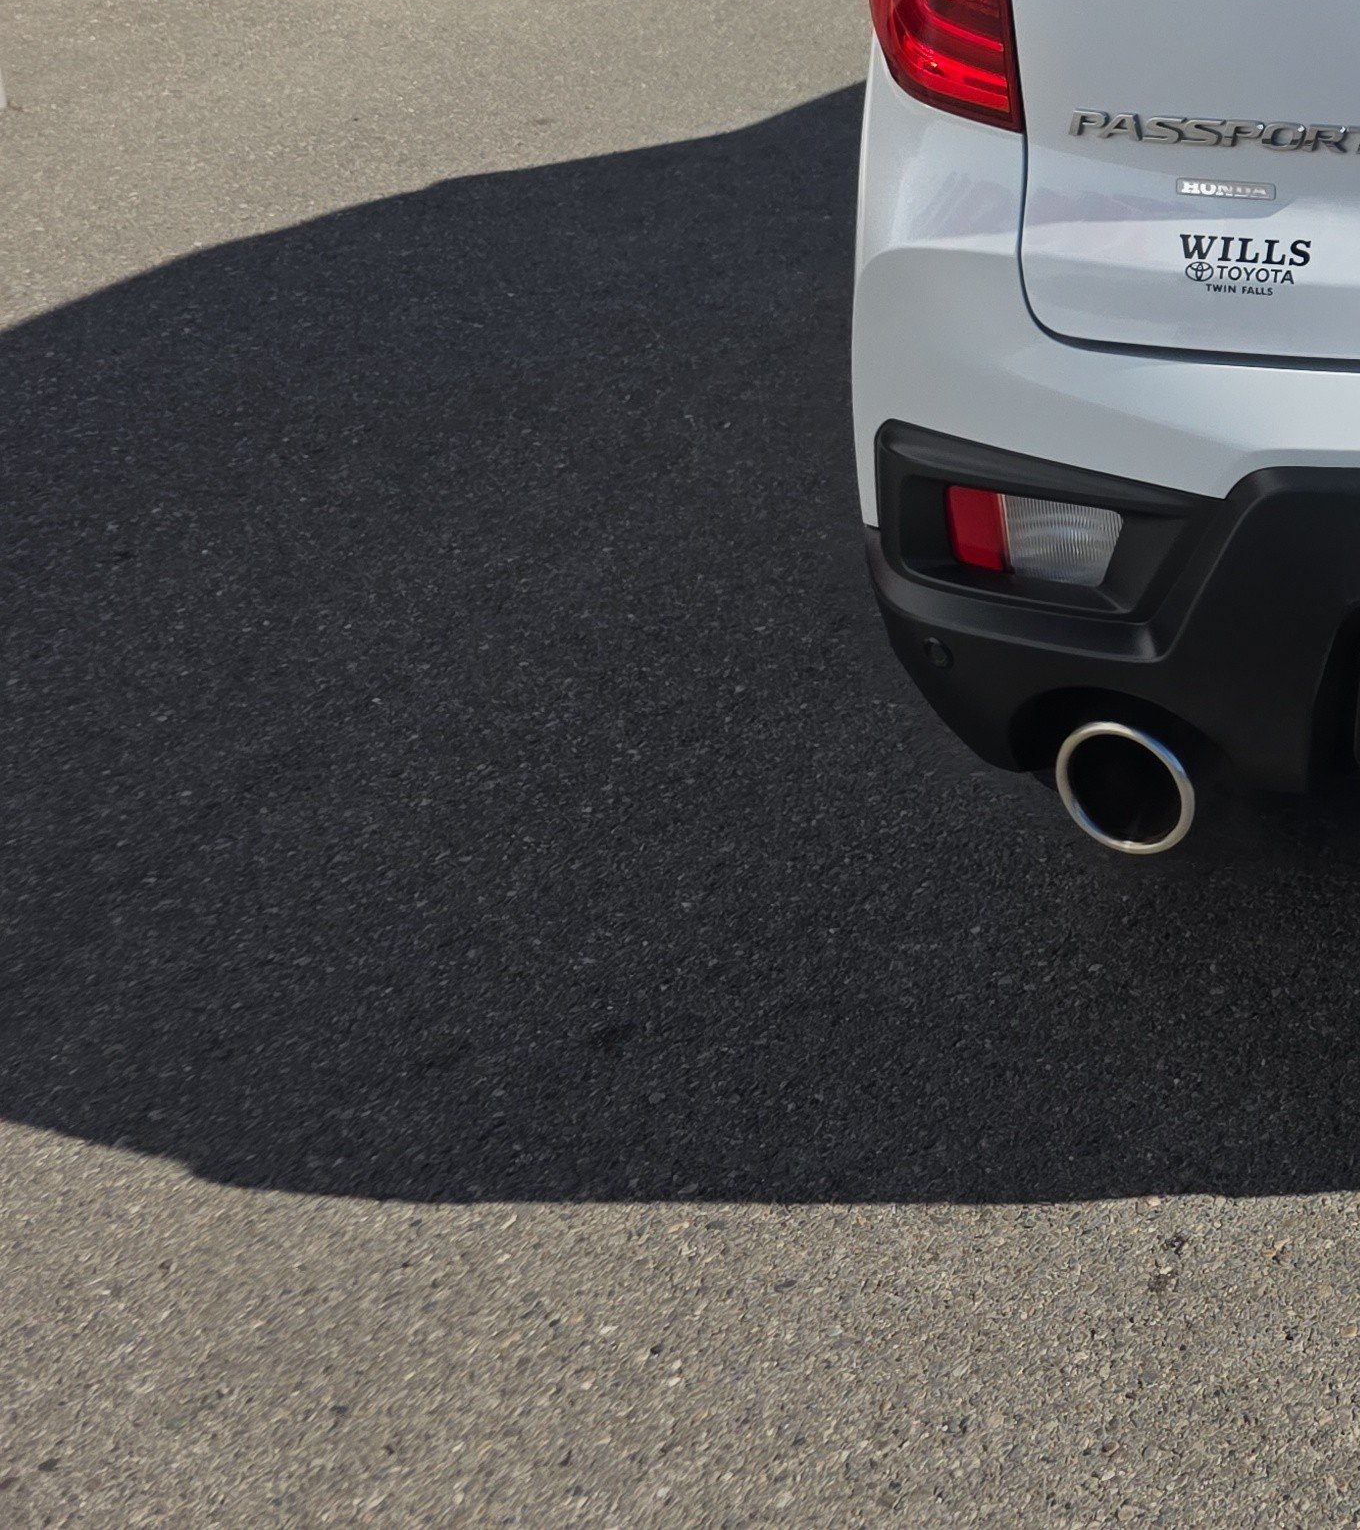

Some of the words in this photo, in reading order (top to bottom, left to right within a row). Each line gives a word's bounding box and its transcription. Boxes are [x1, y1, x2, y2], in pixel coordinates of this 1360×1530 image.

[1181, 179, 1269, 199] HONDA
[1179, 233, 1312, 267] WILLS
[1216, 265, 1294, 285] TOYOTA
[1206, 283, 1237, 294] TWIN
[1242, 286, 1274, 297] FALLS
